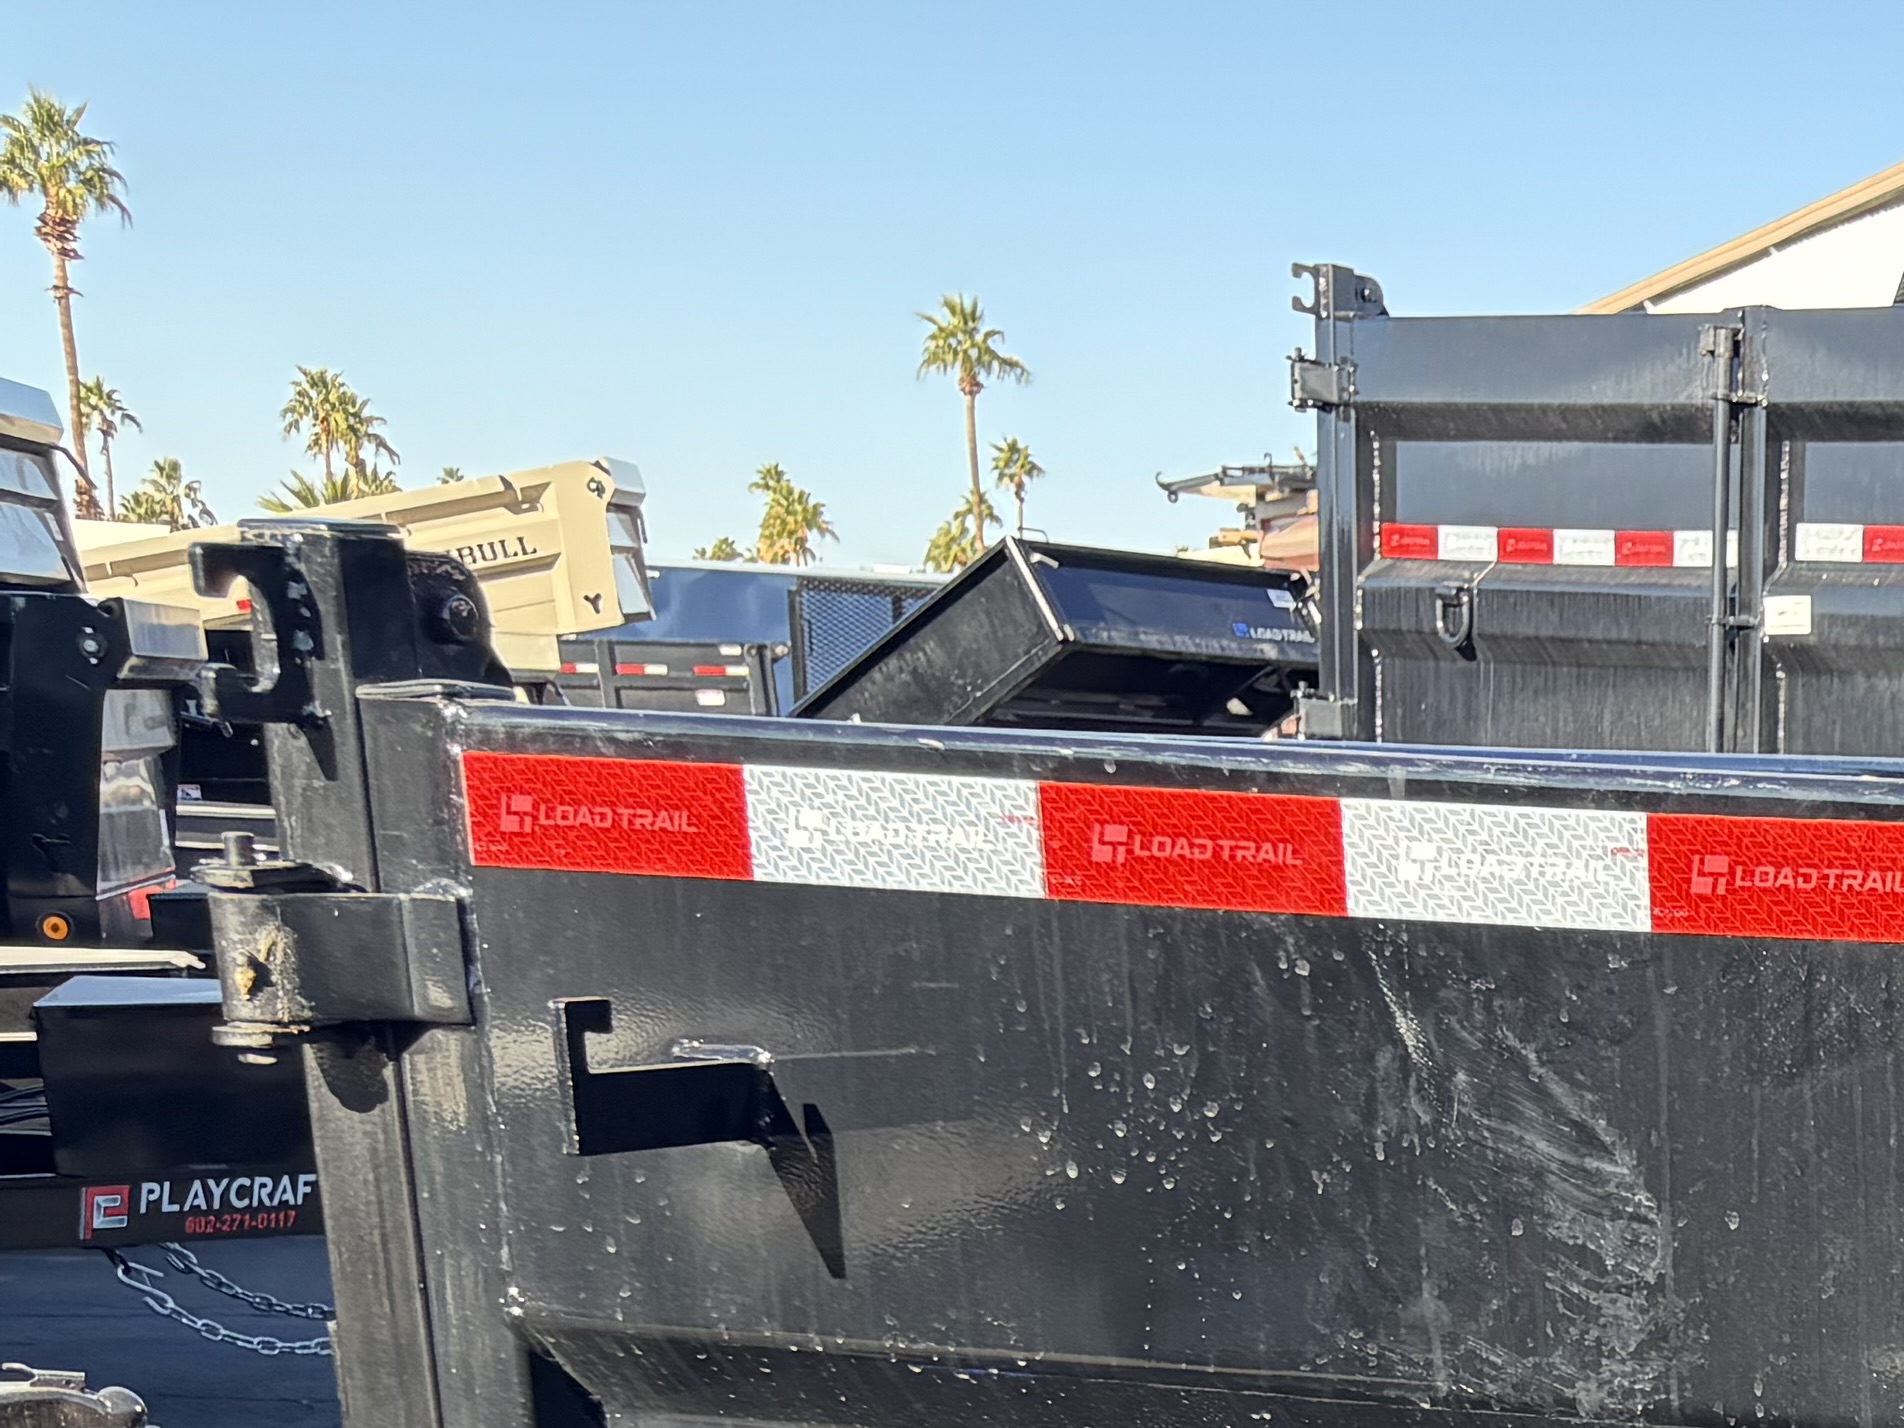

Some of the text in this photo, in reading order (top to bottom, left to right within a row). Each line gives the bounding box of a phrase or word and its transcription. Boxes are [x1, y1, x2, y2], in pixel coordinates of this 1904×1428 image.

[456, 536, 538, 565] BULL
[539, 804, 700, 833] LOAD TRAIL
[1134, 834, 1303, 865] LOAD TRAIL
[1734, 865, 1818, 890] LOAD
[138, 1173, 317, 1215] PLAYCRAF
[185, 1210, 297, 1235] 602-271-0117
